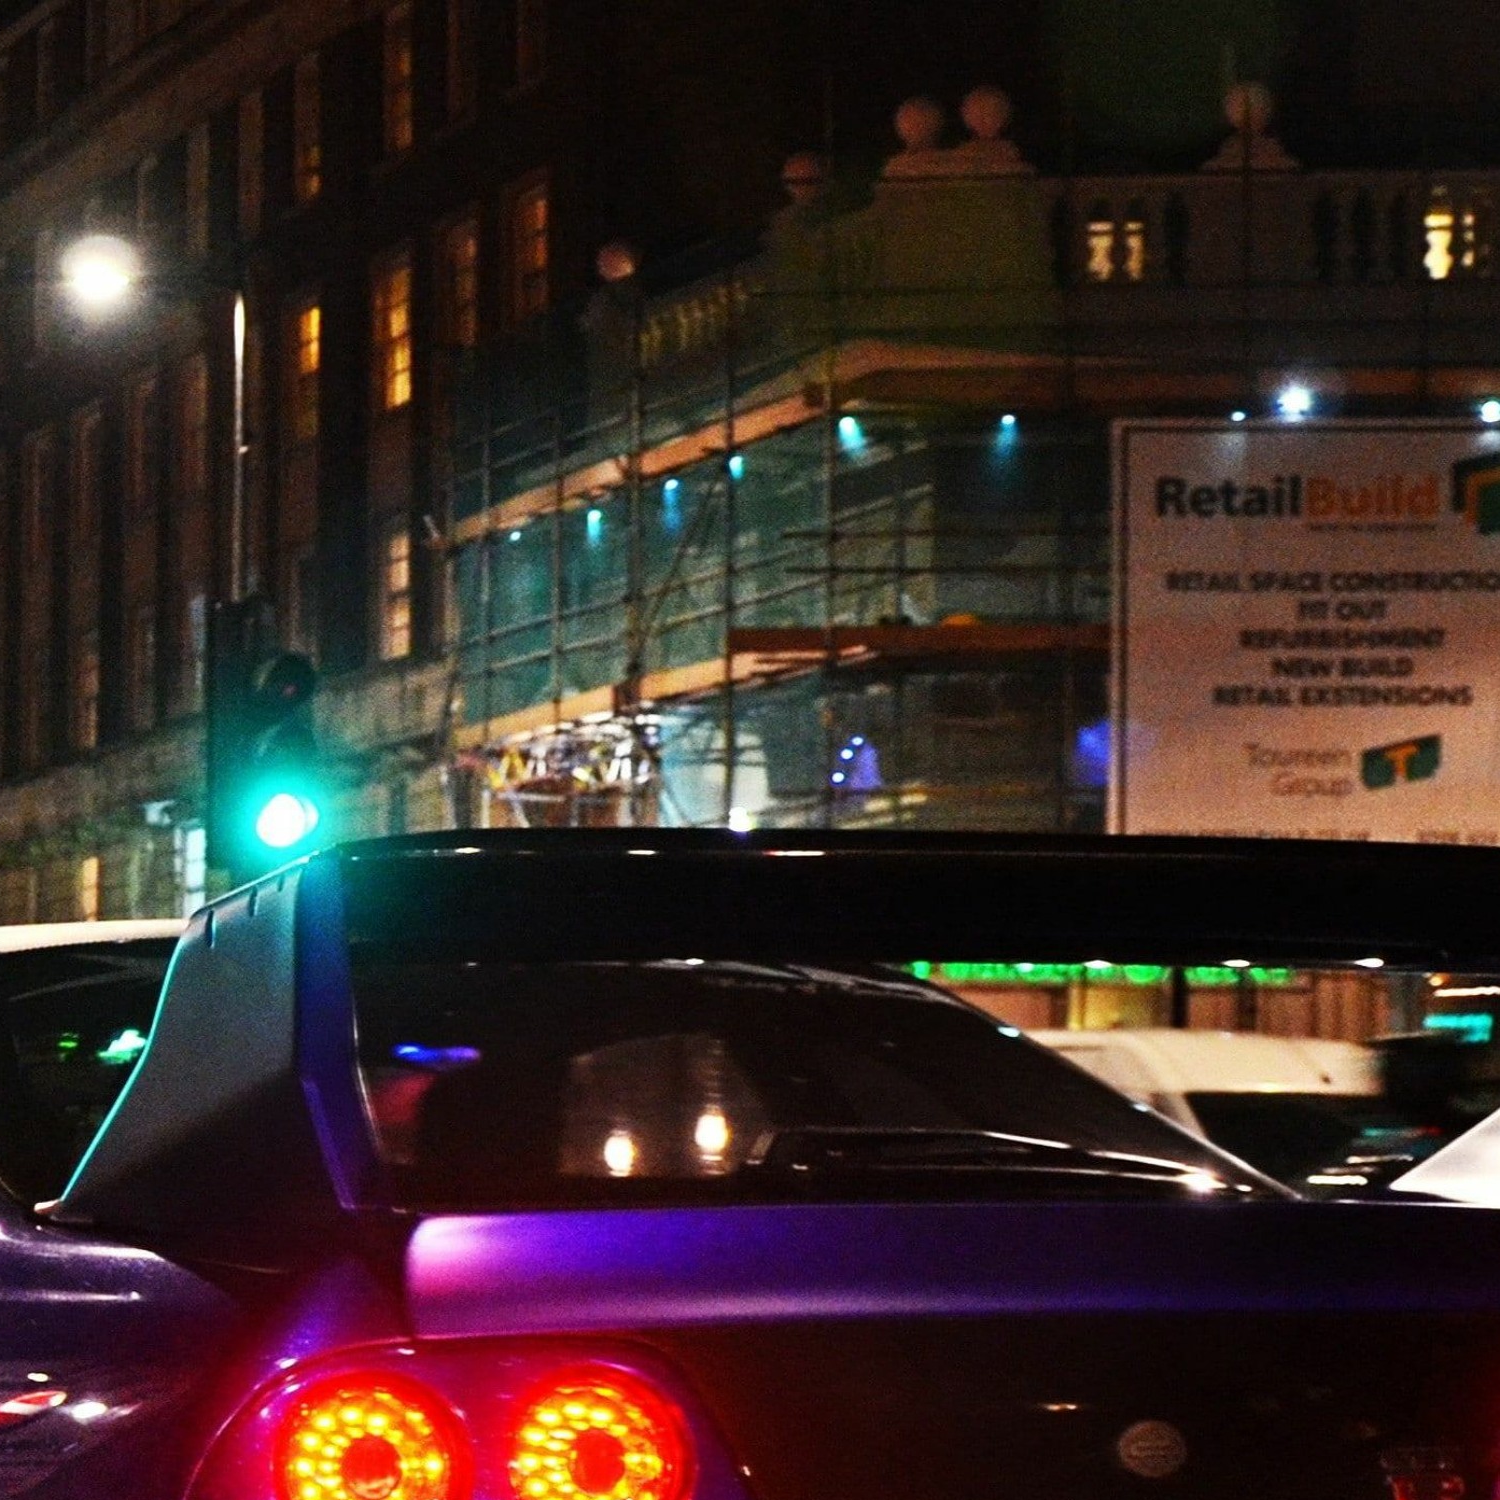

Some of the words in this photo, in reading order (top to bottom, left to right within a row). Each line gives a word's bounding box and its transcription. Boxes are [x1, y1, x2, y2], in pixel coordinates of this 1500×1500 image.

[1154, 474, 1440, 519] RetailBuild
[1166, 571, 1241, 592] RETAIL
[1249, 571, 1323, 592] SPACE
[1336, 601, 1387, 620] OUT
[1271, 657, 1331, 678] NEW
[1338, 657, 1414, 678] BUILD
[1212, 685, 1291, 706] RETAIL
[1300, 686, 1474, 706] EXTENSIONS
